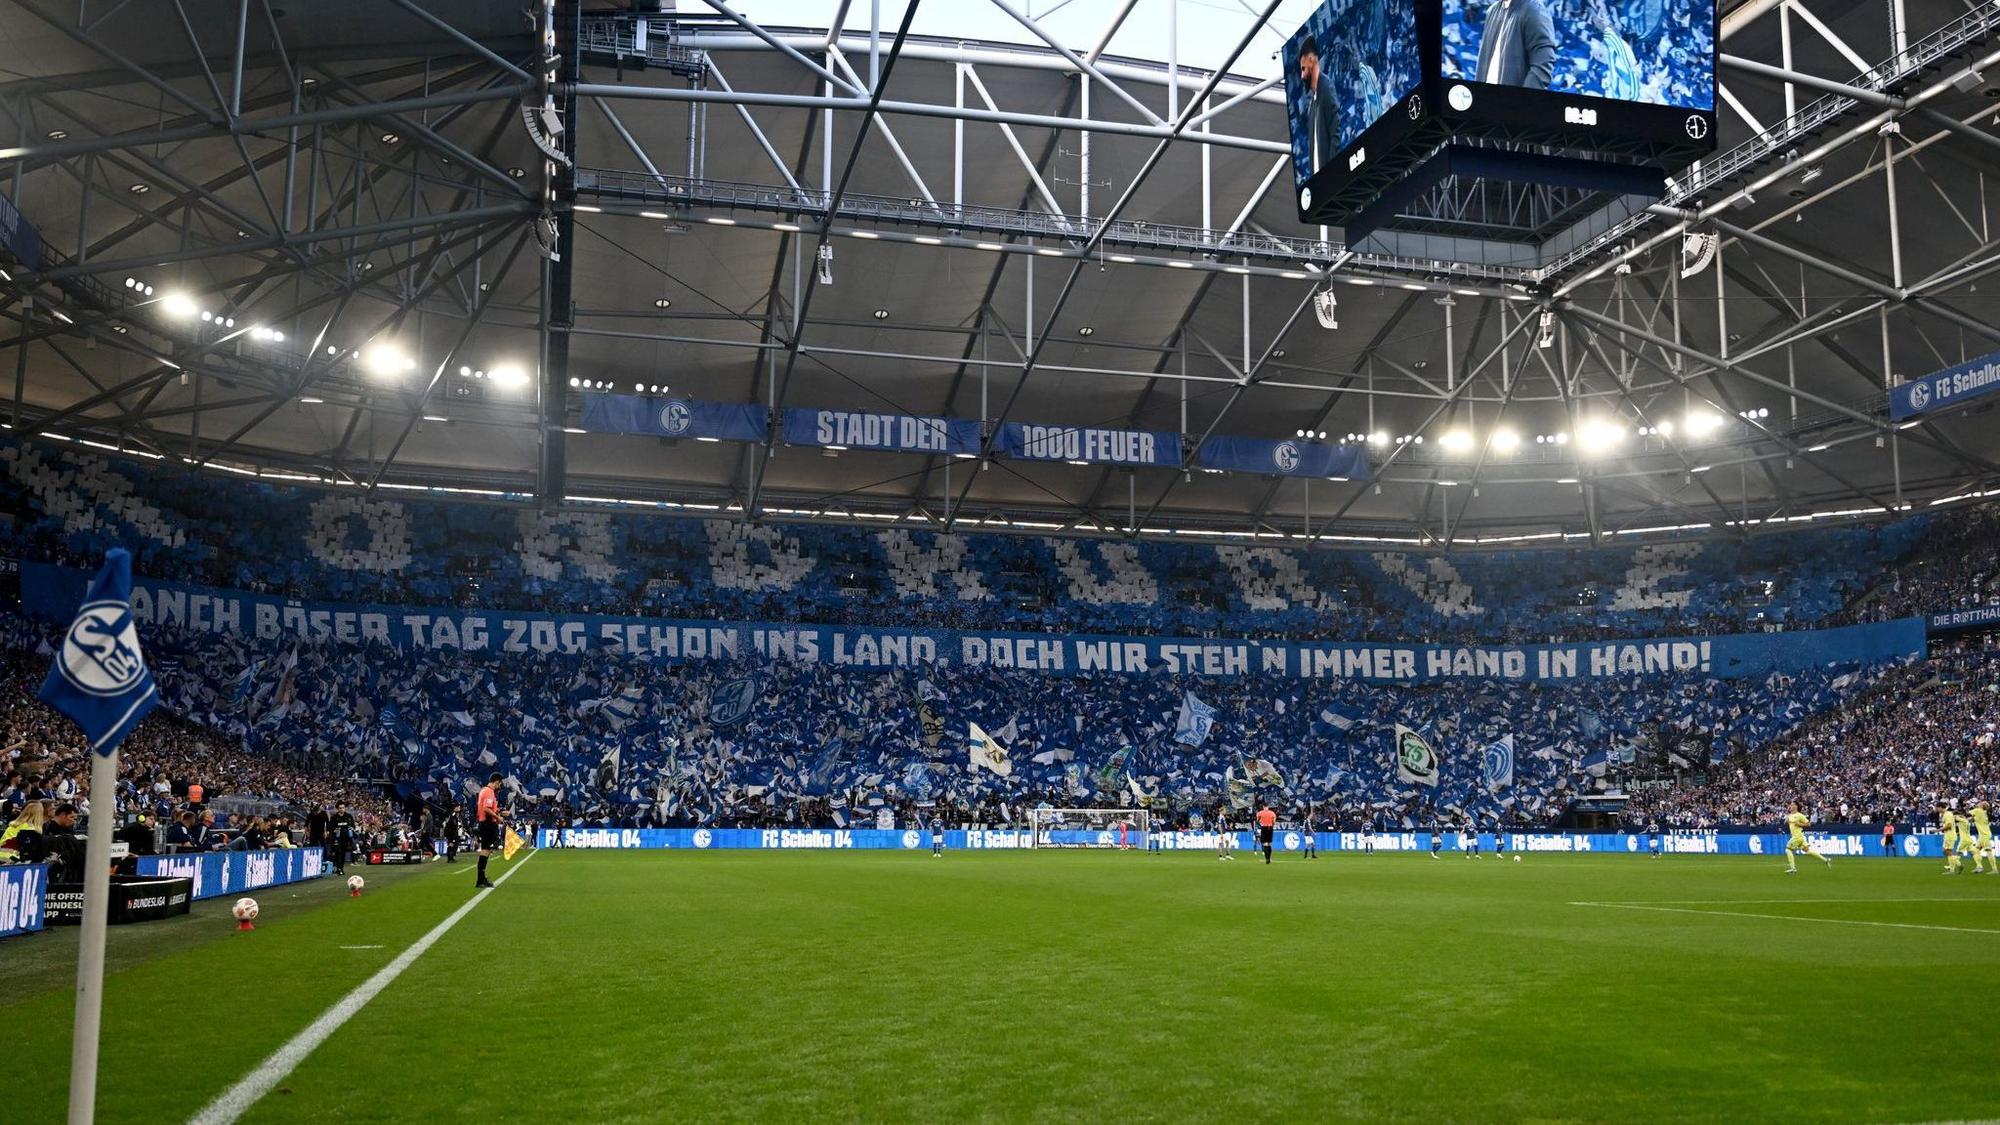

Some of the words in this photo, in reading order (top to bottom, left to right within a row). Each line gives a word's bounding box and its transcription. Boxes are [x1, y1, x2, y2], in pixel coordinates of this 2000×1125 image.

[1936, 377, 1951, 400] FC
[817, 411, 895, 447] STADT
[900, 417, 947, 450] DER
[1022, 425, 1079, 459] 1000
[1085, 429, 1155, 463] FEUER
[1934, 614, 1950, 626] DIE
[1952, 607, 2000, 624] ROTTHA
[88, 580, 241, 633] ANCH
[403, 615, 489, 651] TAG
[503, 620, 587, 655] ZOG
[601, 623, 738, 661] SCHON
[754, 630, 819, 663] INS
[833, 633, 936, 666] LAND
[962, 637, 1064, 670] DOCH
[1076, 641, 1148, 673] WIR
[1301, 648, 1417, 679] IMMER
[1427, 648, 1526, 679] HAND
[1539, 649, 1578, 678] IN
[1591, 641, 1711, 678] HAND!
[565, 829, 619, 848] Schalke
[622, 829, 641, 848] 04
[762, 830, 779, 848] FC
[781, 830, 832, 848] Schalke
[834, 830, 853, 848] 04
[966, 831, 982, 848] FC
[1159, 832, 1174, 849] FC
[1341, 833, 1355, 849] FC
[1357, 833, 1399, 849] Salke
[1401, 833, 1417, 849] 04
[1512, 834, 1526, 851] FC
[1527, 834, 1572, 851] Schalke
[1574, 834, 1591, 851] 04
[1706, 835, 1719, 852] 04
[1848, 836, 1864, 855] 04
[19, 869, 40, 928] 04
[133, 896, 166, 909] BUNDESLIGA
